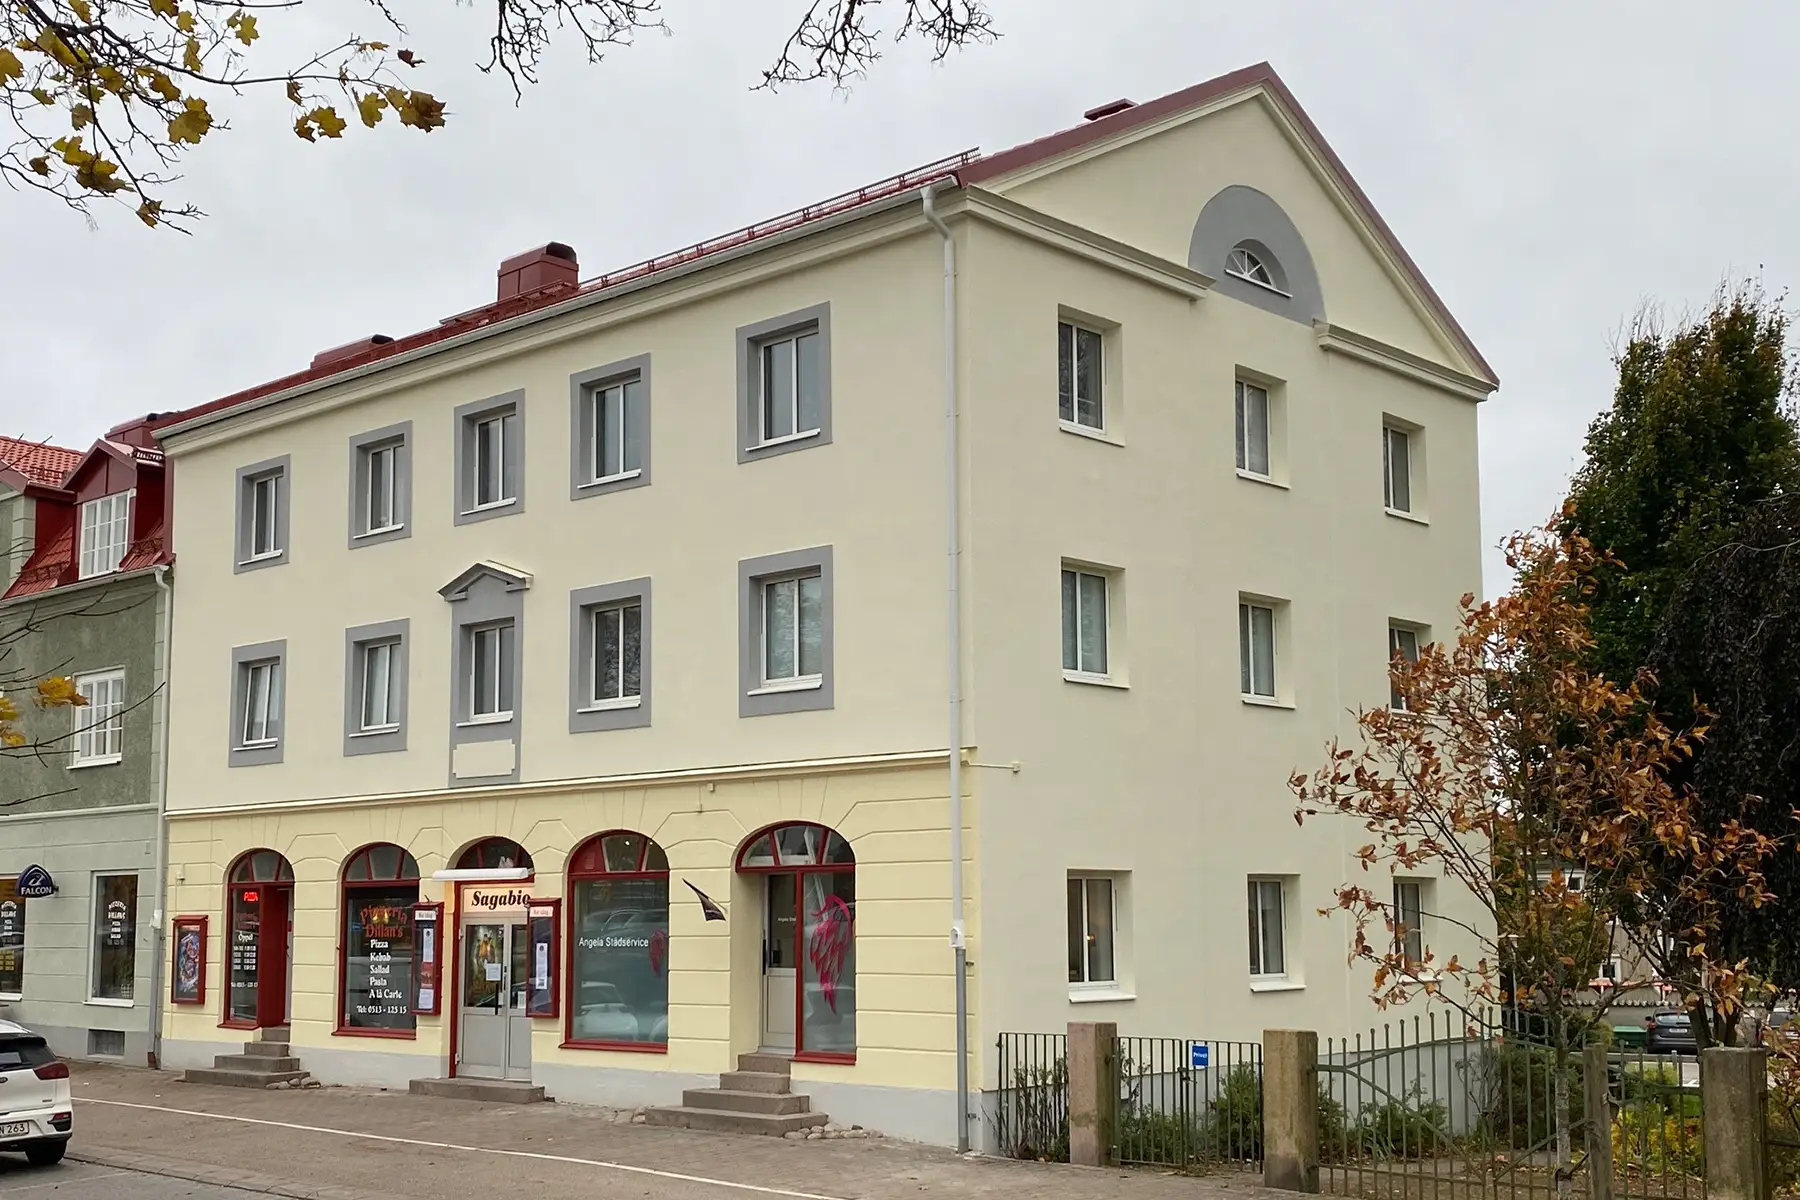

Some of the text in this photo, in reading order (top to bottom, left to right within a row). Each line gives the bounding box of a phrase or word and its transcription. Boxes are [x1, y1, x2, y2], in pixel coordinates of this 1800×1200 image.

[21, 886, 52, 895] FALCON
[471, 890, 531, 910] Sagabio
[370, 939, 388, 948] Pizza
[578, 936, 649, 949] Angela Städservice
[370, 952, 391, 961] Kebab
[369, 964, 390, 974] Sallad
[369, 976, 387, 986] Pasta
[367, 1005, 382, 1014] 0513
[387, 1005, 398, 1014] 125
[400, 1005, 407, 1014] 15
[7, 1123, 25, 1134] 263
